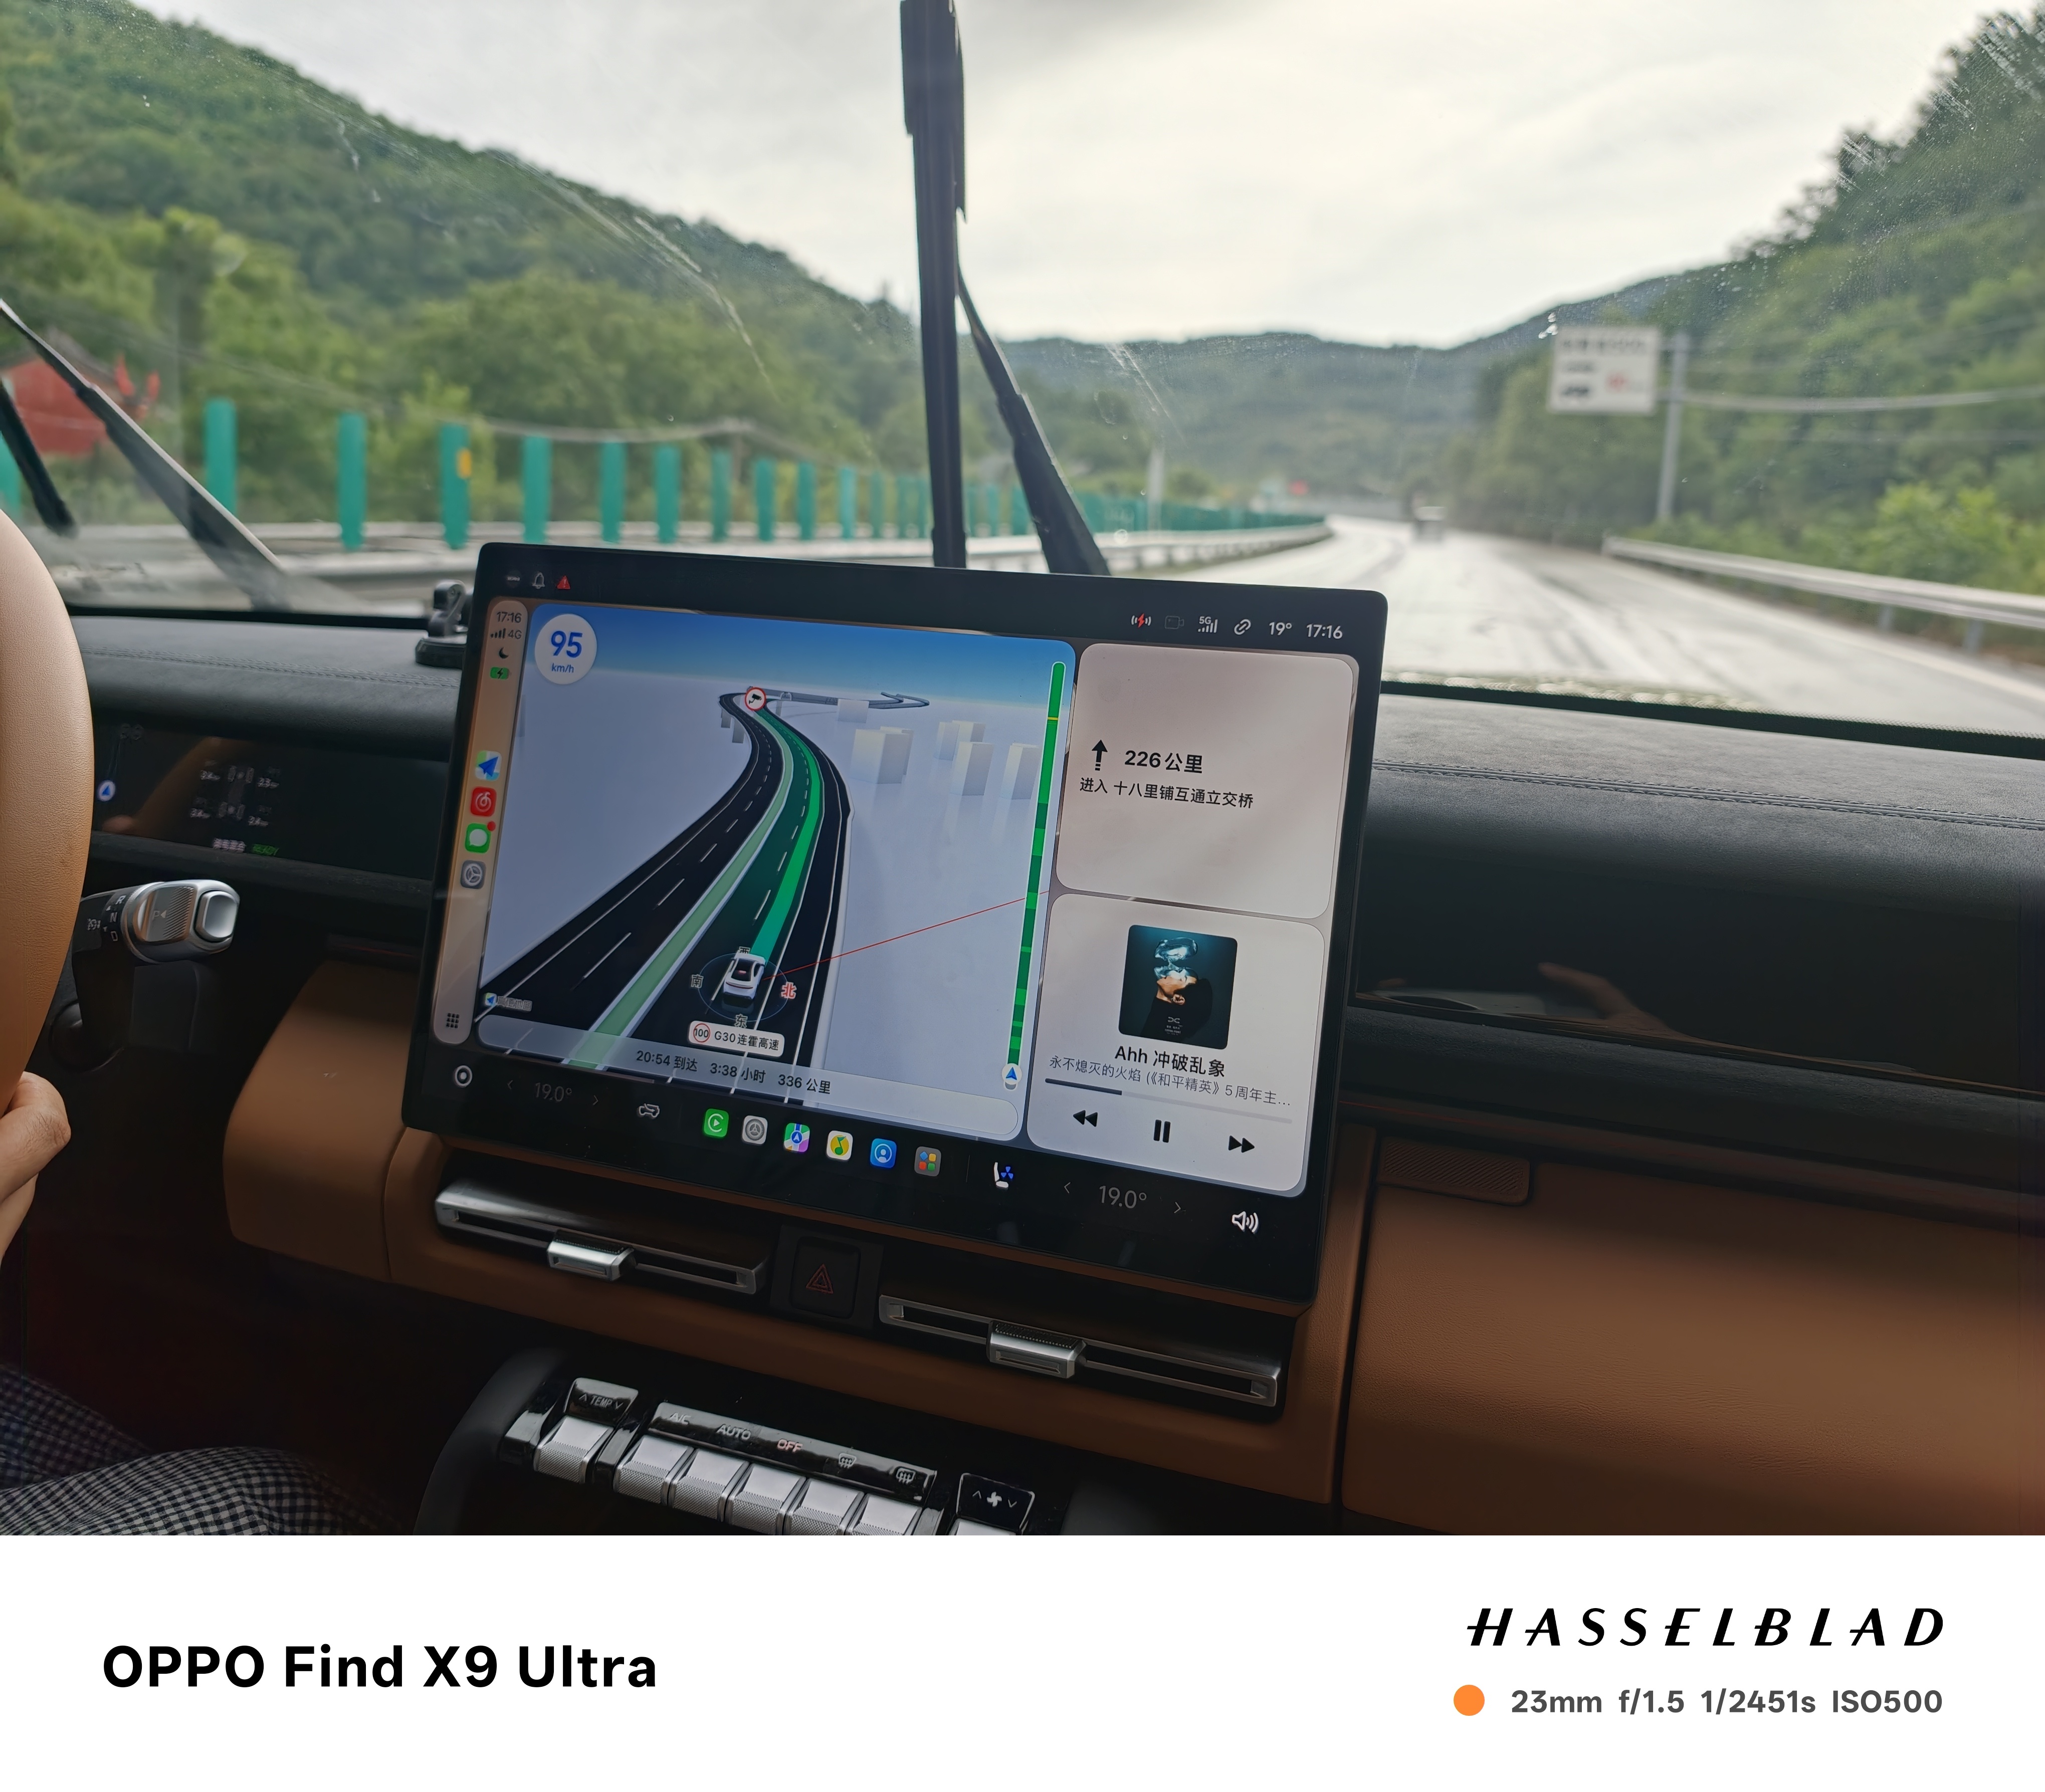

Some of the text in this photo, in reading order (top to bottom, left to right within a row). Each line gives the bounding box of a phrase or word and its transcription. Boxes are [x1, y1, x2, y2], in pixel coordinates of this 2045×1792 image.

[497, 611, 522, 623] 17:16
[1199, 616, 1211, 624] 5G
[508, 629, 522, 639] 4G
[1269, 622, 1292, 635] 19°
[1307, 624, 1343, 639] 17:16
[551, 630, 583, 658] 95
[551, 662, 574, 674] km/h
[1080, 777, 1254, 809] 进入 十八里铺互通立交桥
[115, 895, 126, 905] R
[110, 912, 117, 923] N
[110, 931, 118, 942] D
[691, 974, 703, 987] 南
[781, 982, 797, 999] 北
[734, 1014, 748, 1028] 东
[694, 1028, 779, 1051] 100 G30连霍高速
[1049, 1055, 1141, 1082] 永不熄灭的火焰
[1115, 1046, 1225, 1077] Ahh 冲破乱象
[636, 1050, 831, 1094] 20:54 到达 3:38 小时 336 公里
[535, 1082, 572, 1102] 19.0°
[1099, 1185, 1147, 1209] 19.0°
[589, 1395, 612, 1408] TEMP
[669, 1412, 692, 1425] A/C
[716, 1424, 752, 1441] AUTO
[777, 1438, 803, 1452] OFF
